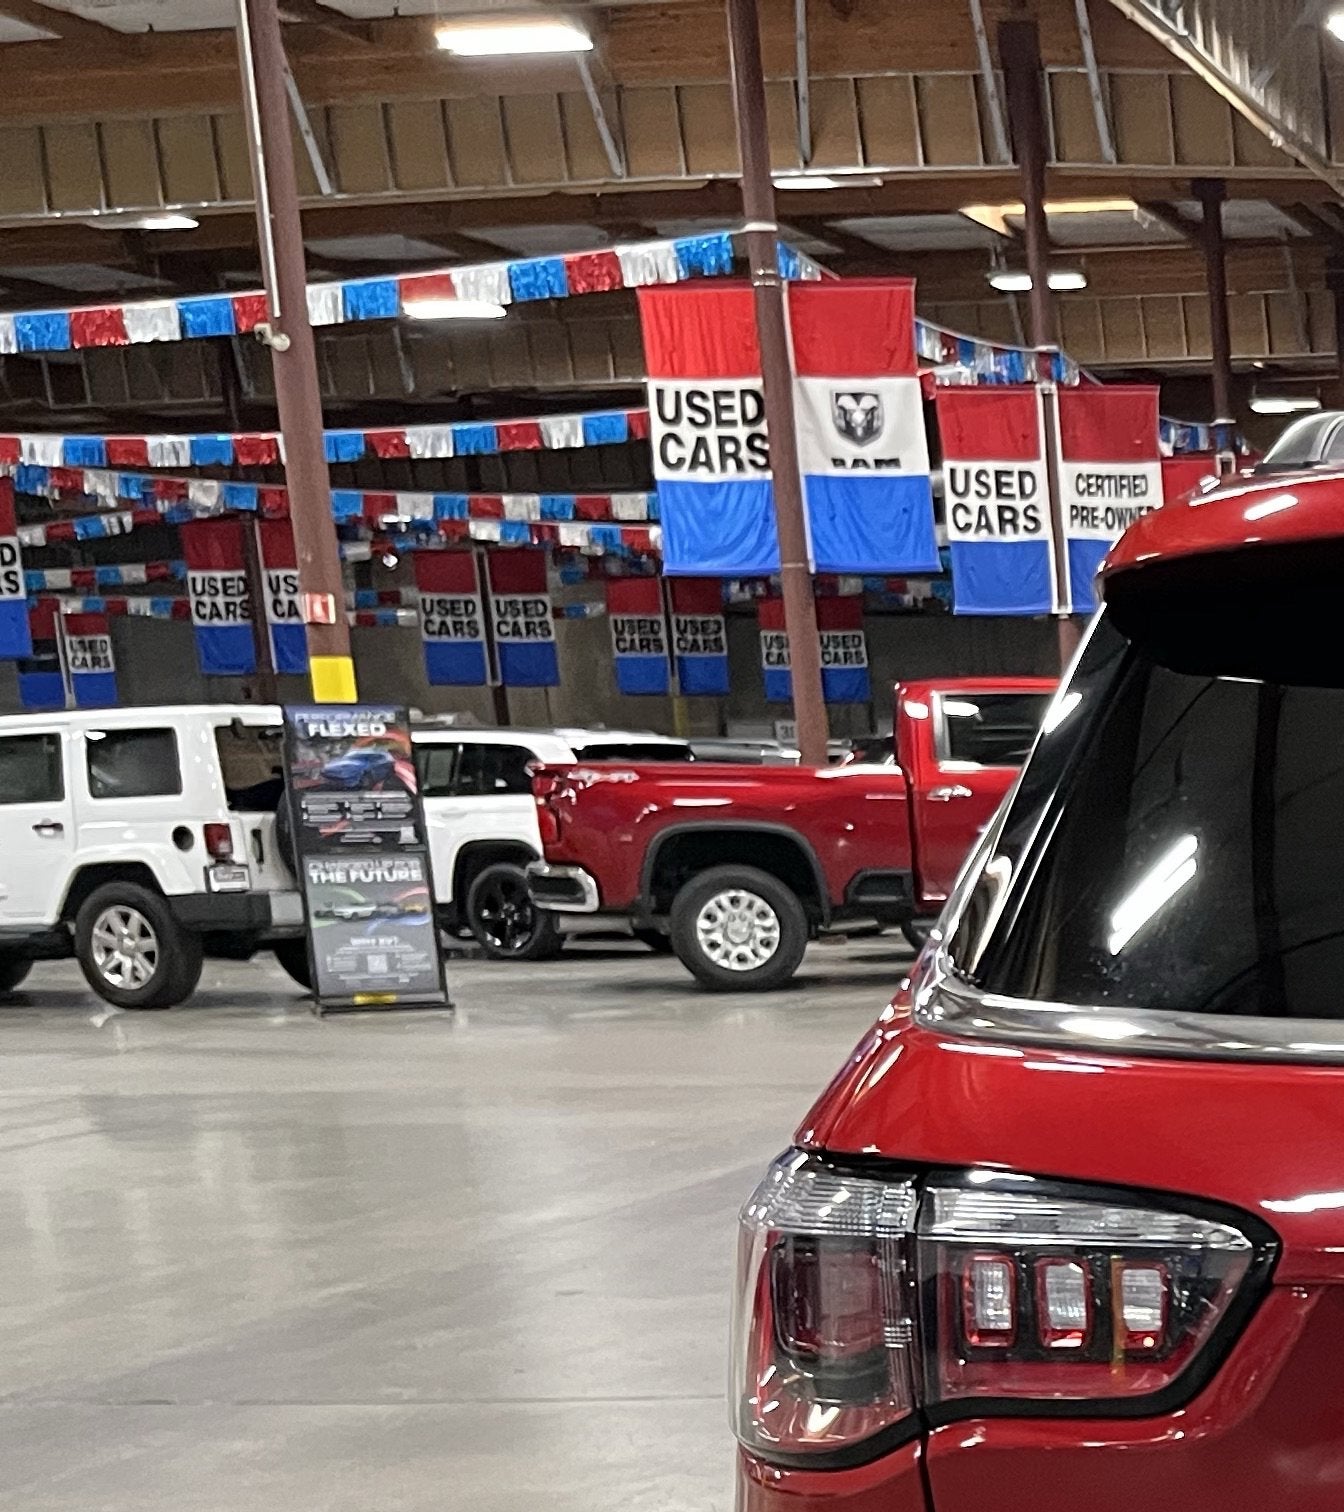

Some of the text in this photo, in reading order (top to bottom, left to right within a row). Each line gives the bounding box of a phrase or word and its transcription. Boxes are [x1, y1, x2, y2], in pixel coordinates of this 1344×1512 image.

[656, 388, 765, 428] USED
[660, 432, 770, 473] CARS
[950, 468, 1037, 500] USED
[1076, 472, 1148, 498] CERTIFIED
[952, 503, 1041, 535] CARS
[191, 576, 249, 597] USED
[268, 574, 298, 596] US
[195, 601, 251, 621] CARS
[272, 599, 301, 618] CA
[421, 598, 476, 617] USED
[495, 598, 548, 618] USED
[423, 620, 480, 638] CARS
[496, 620, 552, 638] CARS
[614, 618, 661, 635] USED
[676, 618, 722, 635] USED
[615, 638, 664, 654] CARS
[307, 722, 387, 737] FLEXED
[310, 869, 422, 884] THE FUTURE
